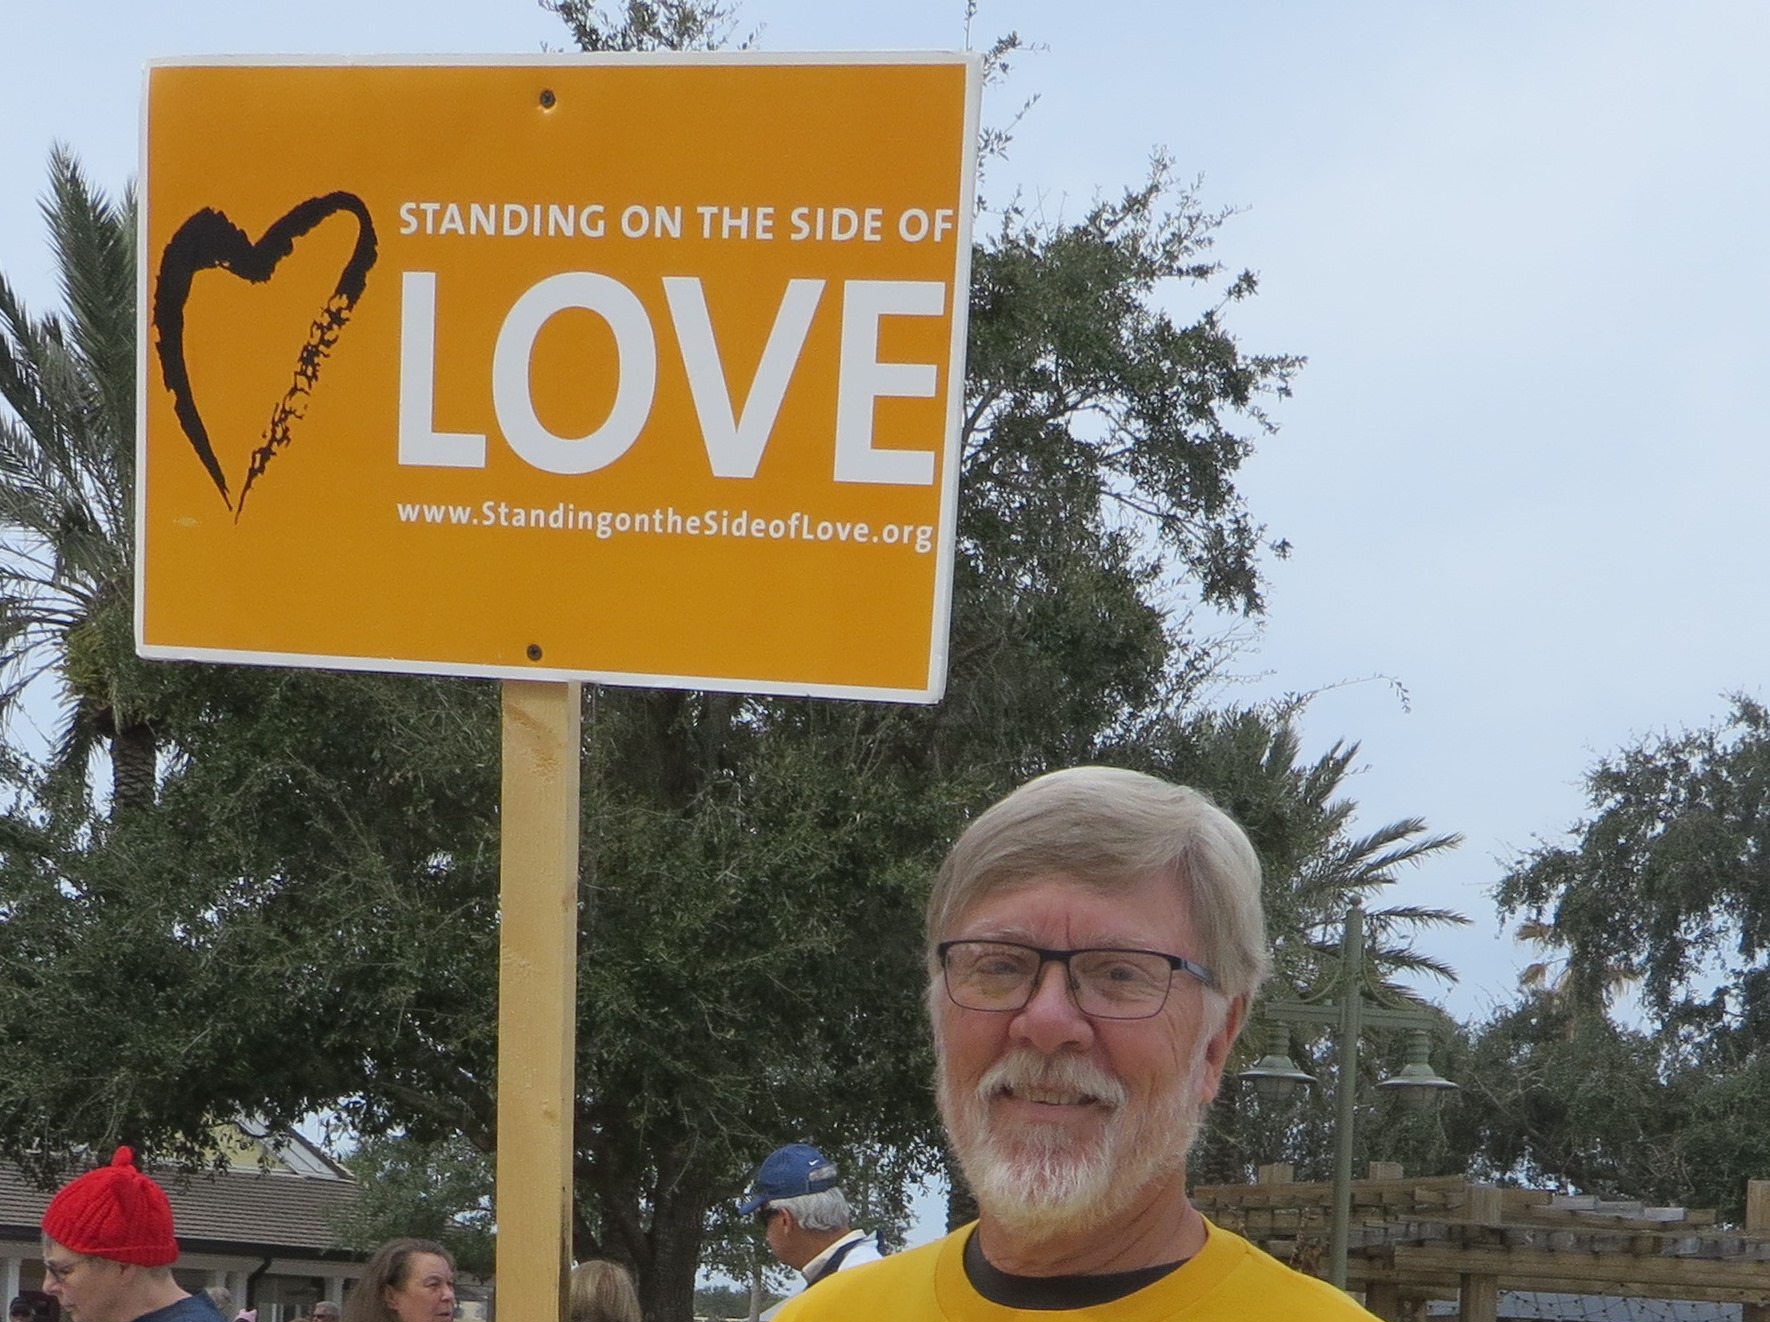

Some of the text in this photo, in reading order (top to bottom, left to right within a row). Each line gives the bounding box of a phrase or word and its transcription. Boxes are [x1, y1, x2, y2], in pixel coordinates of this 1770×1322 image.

[399, 202, 954, 243] STANDING ON THE SIDE OF
[397, 270, 947, 486] LOVE
[397, 501, 934, 554] www.StandingontheSideofLove.org
